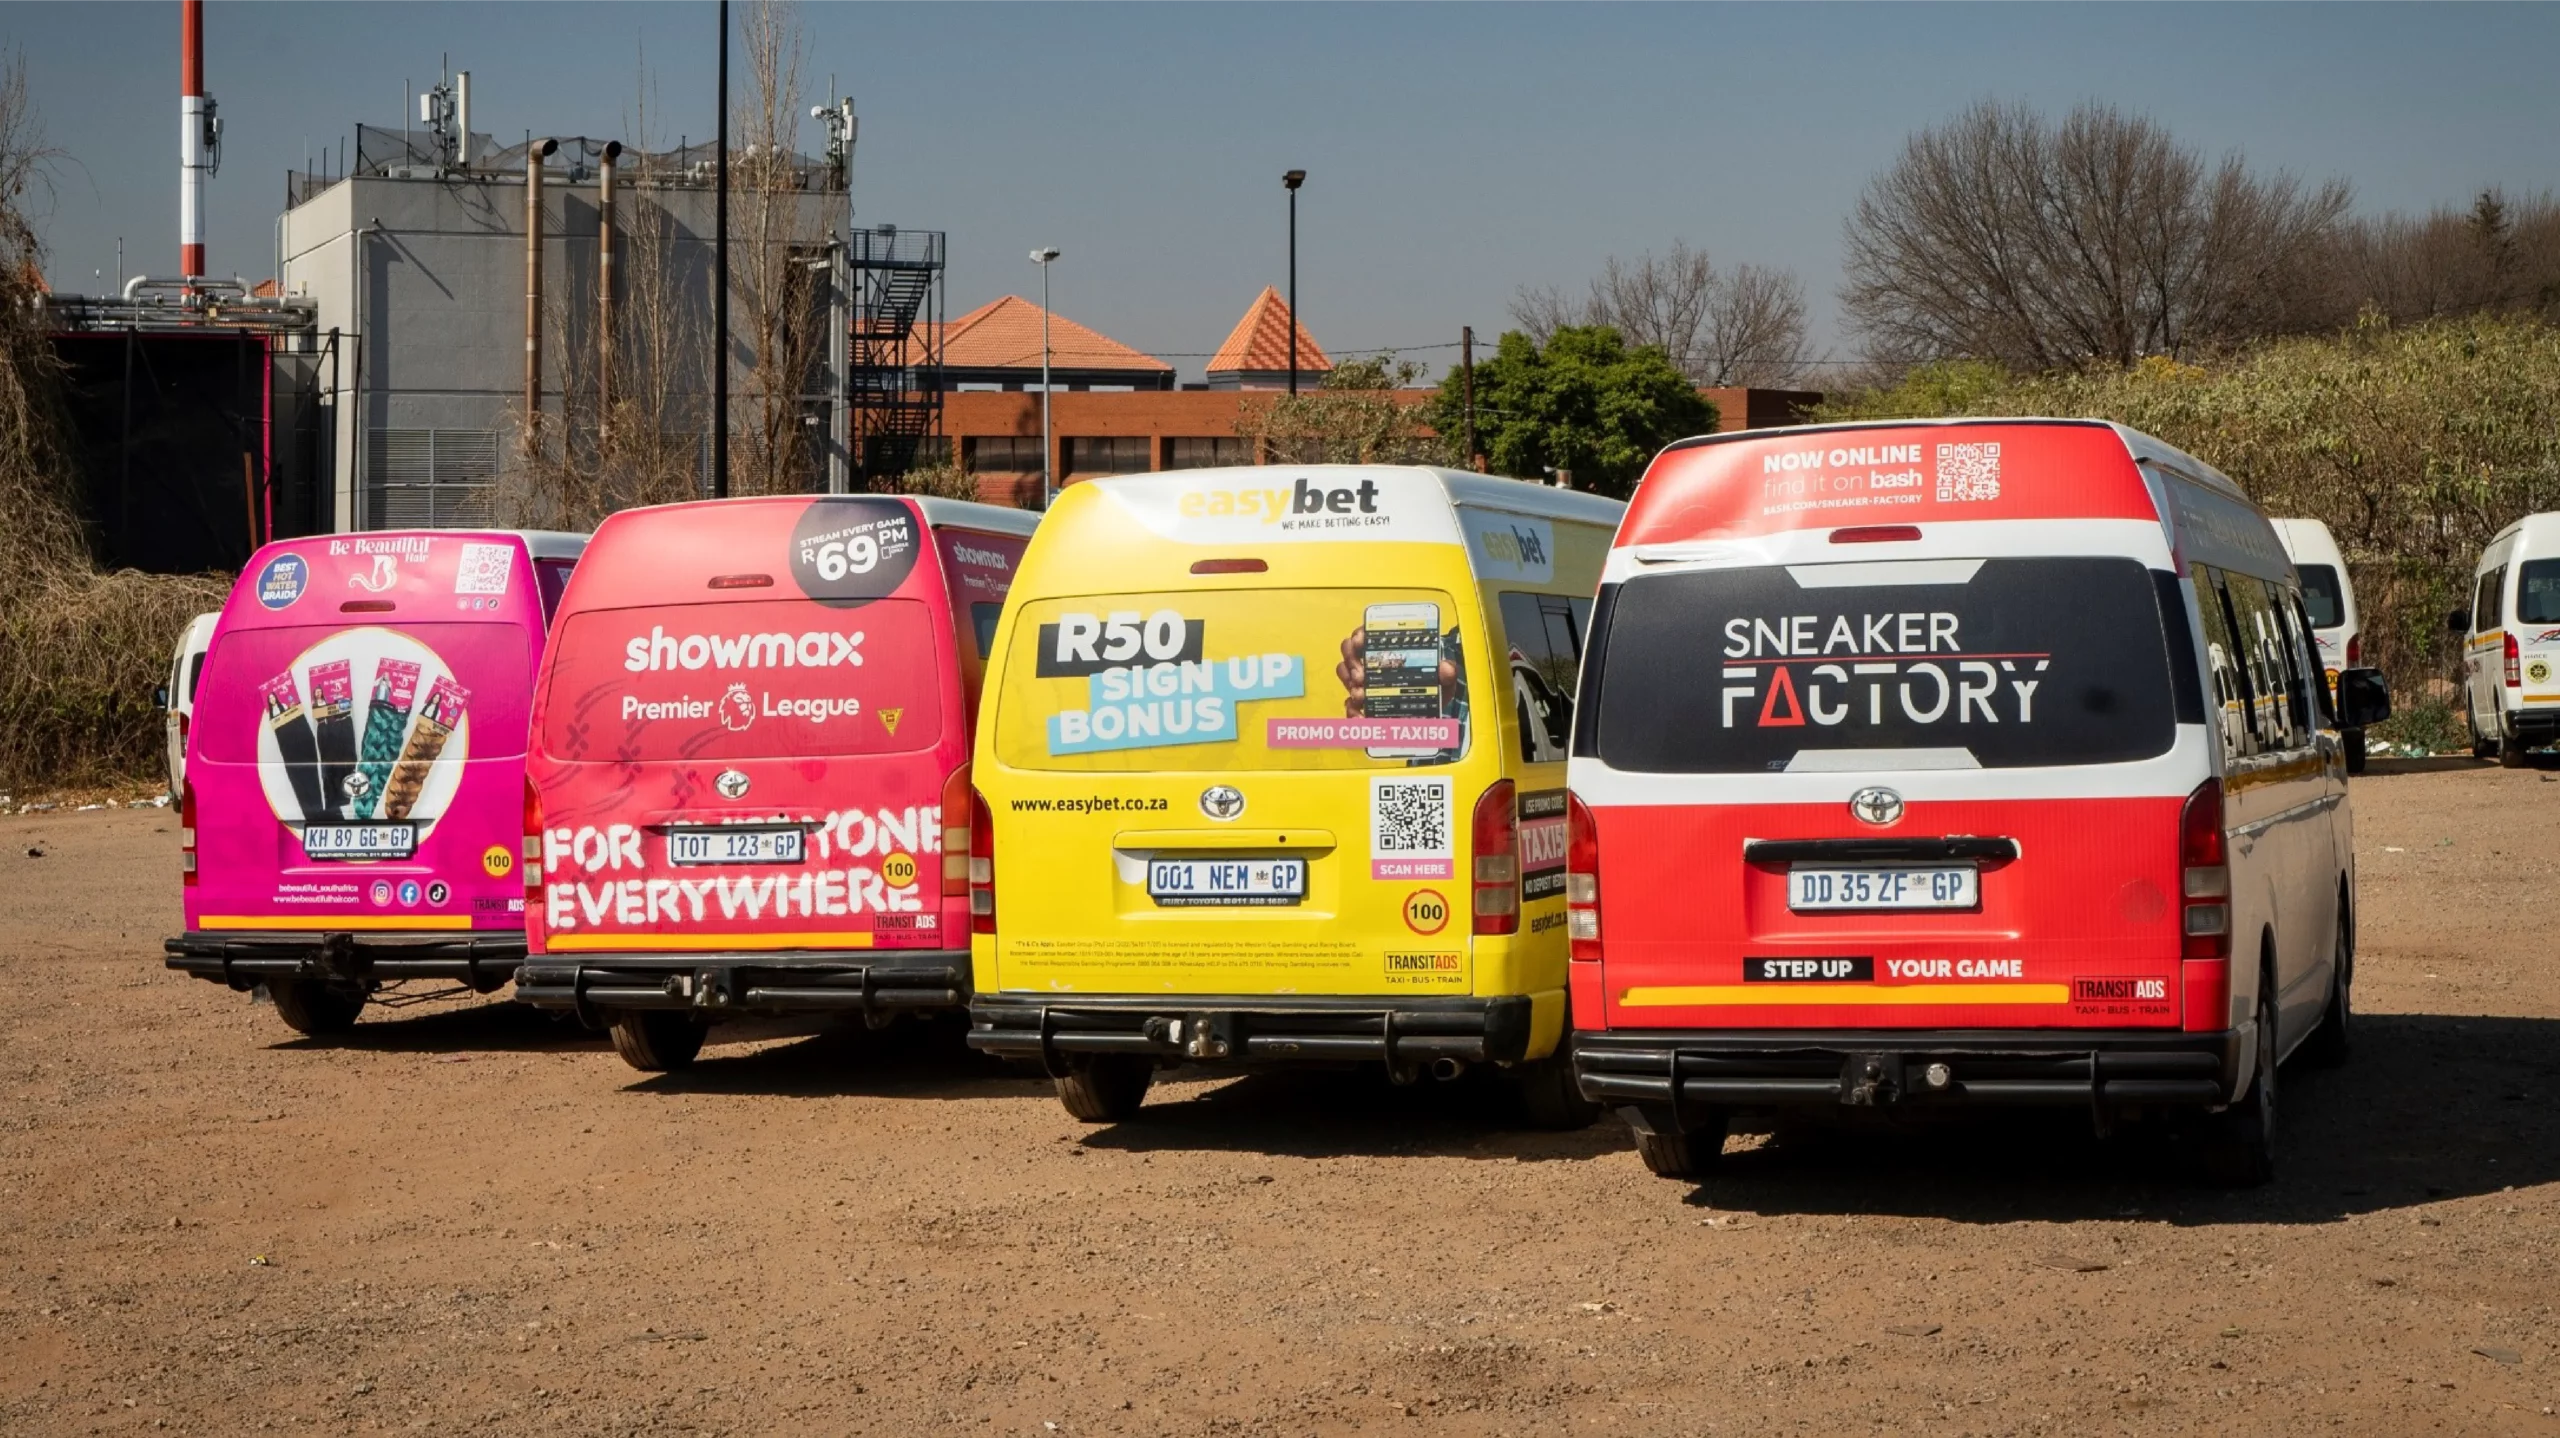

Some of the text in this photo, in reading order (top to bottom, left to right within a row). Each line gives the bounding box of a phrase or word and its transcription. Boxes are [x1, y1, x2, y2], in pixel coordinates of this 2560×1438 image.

[1763, 444, 1923, 474] NOW ONLINE
[1763, 468, 1923, 499] find it on bash
[1179, 478, 1379, 525] easybet
[799, 516, 906, 548] STREAM EVERY GAME
[1281, 515, 1390, 530] WE MAKE BETTING EASY!
[879, 527, 909, 545] PM
[329, 537, 430, 556] Be Beautiful
[953, 540, 1009, 571] showmax
[1481, 524, 1547, 573] easybet
[405, 552, 429, 563] Hair
[273, 562, 298, 573] BEST
[273, 571, 294, 582] HOT
[262, 590, 297, 601] BRAIDS
[265, 580, 298, 592] WATER
[1056, 609, 1187, 664] R50
[1723, 612, 1961, 658] SNEAKER
[624, 625, 865, 672] showmax
[1102, 653, 1293, 701] SIGN UP
[1722, 660, 2050, 728] FACTORY
[622, 692, 860, 724] Premier League
[1060, 697, 1226, 745] BONUS
[1276, 725, 1449, 742] PROMO CODE: TAXI50
[1011, 795, 1169, 815] www.easybet.co.za
[1525, 799, 1535, 814] USE
[309, 828, 409, 848] KH 89 GG GP
[678, 834, 796, 858] TOT 123 GP
[543, 825, 644, 874] FOR
[485, 855, 510, 868] 100
[885, 863, 914, 877] 100
[1380, 864, 1446, 876] SCAN HERE
[1156, 865, 1298, 890] 001 NEM GP
[1525, 880, 1533, 894] NO
[1802, 872, 1963, 903] DD 35 ZF GP
[473, 898, 525, 912] TRANSITADS
[546, 867, 924, 929] EVERYWHERE
[876, 914, 936, 929] TRANSITADS
[1409, 903, 1444, 921] 100
[1387, 954, 1458, 969] TRANSITADS
[1764, 959, 2023, 978] STEP UP YOUR GAME
[1385, 976, 1463, 984] TAXI BUS TRAIN
[2078, 980, 2165, 998] TRANSITADS
[2075, 1005, 2170, 1014] TAXI BUS TRAIN
